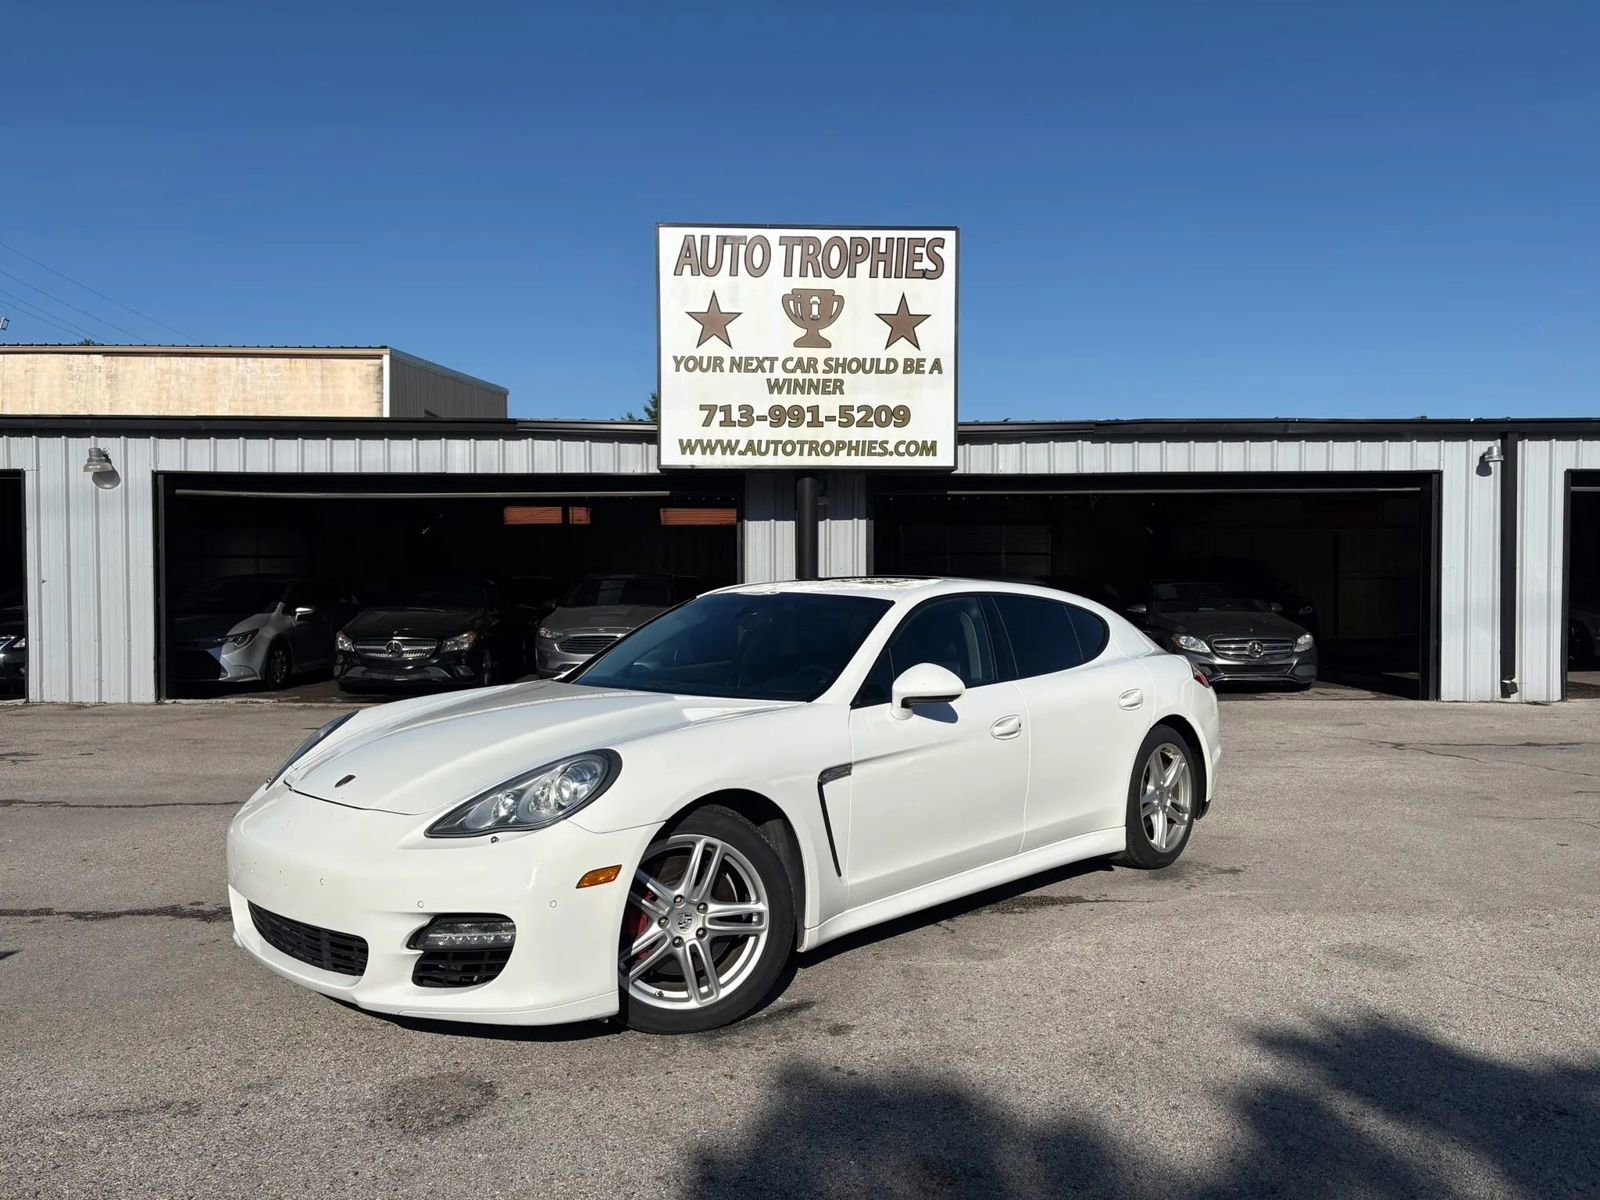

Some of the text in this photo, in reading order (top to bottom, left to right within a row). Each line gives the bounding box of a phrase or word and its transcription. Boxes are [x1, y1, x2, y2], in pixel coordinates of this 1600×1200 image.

[673, 234, 946, 280] AUTO TROPHIES
[672, 355, 943, 374] YOUR NEXT CAR SHOULD BE A
[766, 378, 845, 395] WINNER
[699, 404, 911, 428] 713-991-5209
[678, 438, 937, 457] WWW.AUTOTROPHIES.COM
